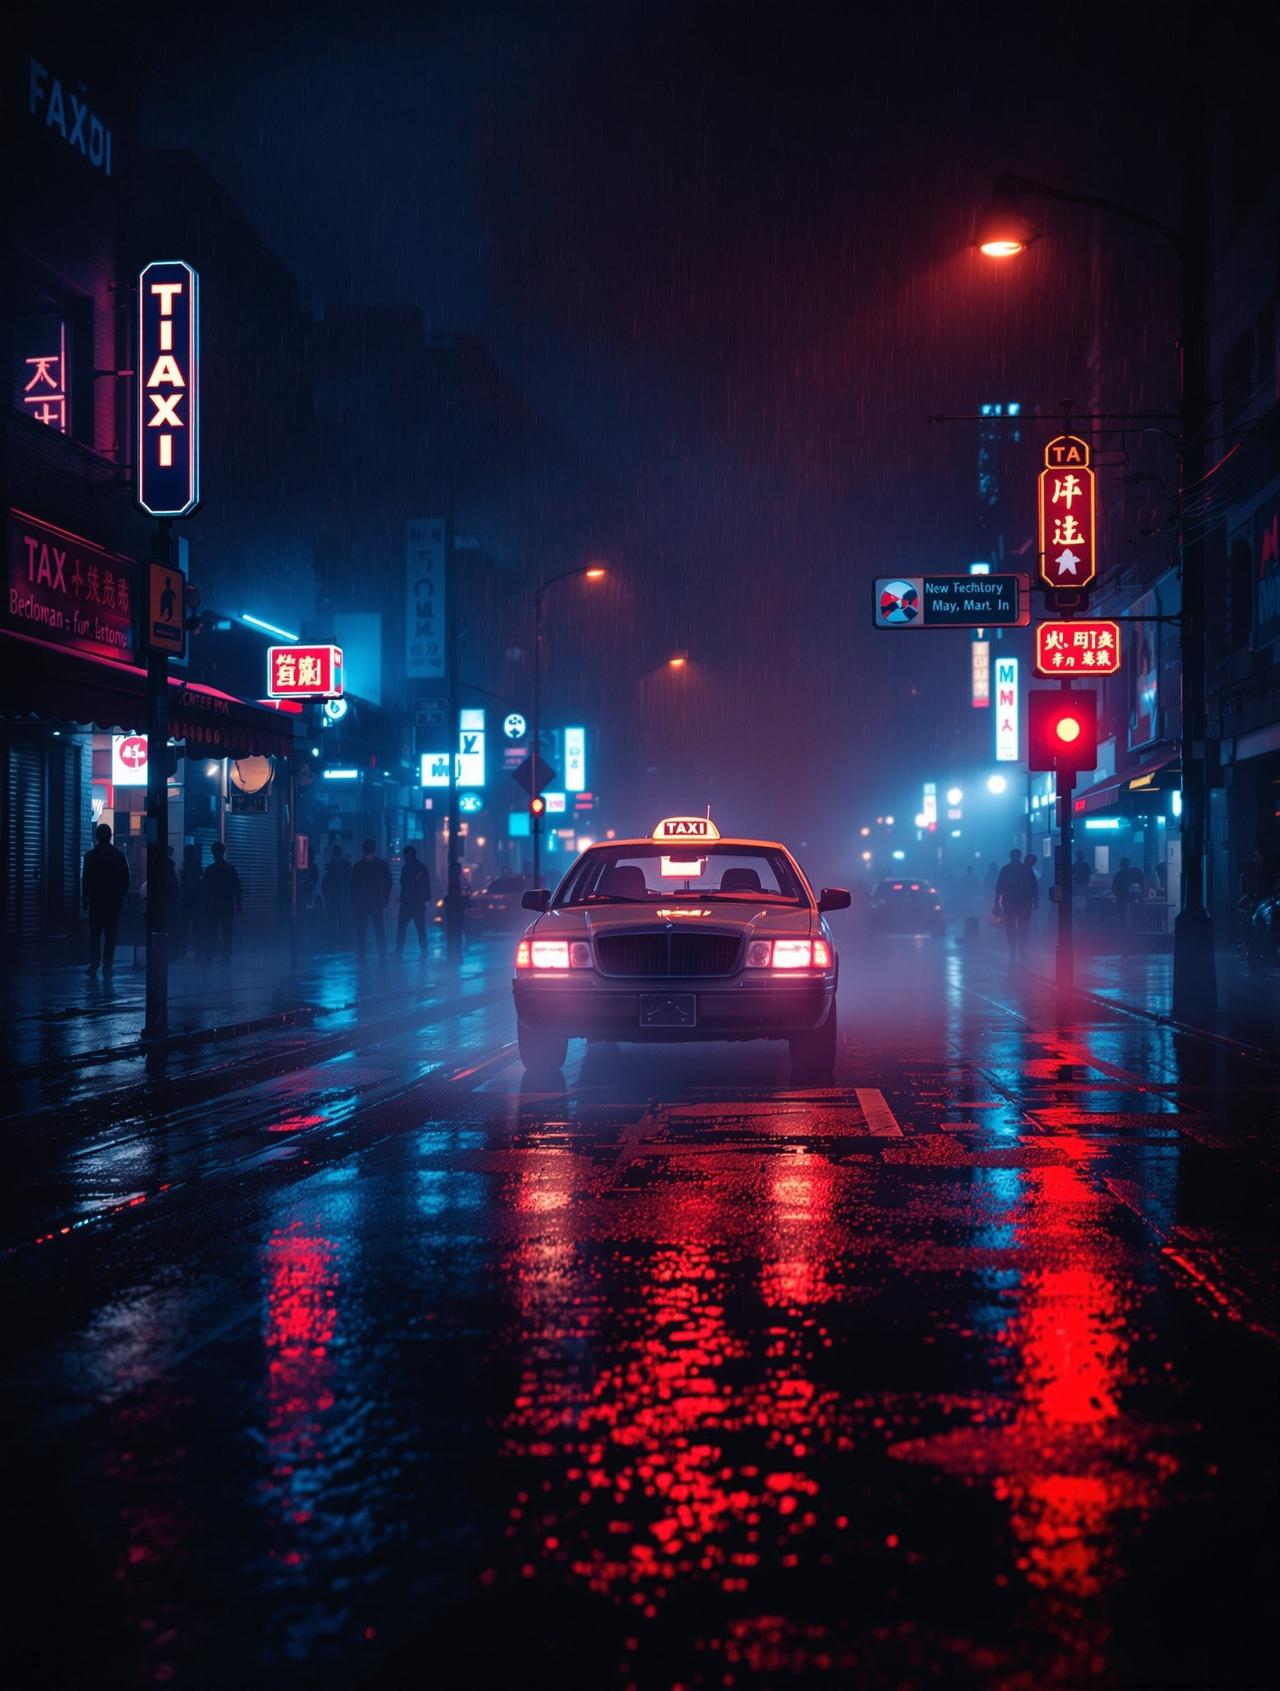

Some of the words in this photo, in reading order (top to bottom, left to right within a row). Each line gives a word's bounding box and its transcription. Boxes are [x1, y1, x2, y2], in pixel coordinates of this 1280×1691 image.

[147, 283, 186, 467] TIAXI
[1053, 446, 1081, 463] TA
[23, 535, 68, 594] TAX
[925, 583, 949, 594] New
[932, 600, 960, 613] May,
[666, 822, 705, 834] TAXI
